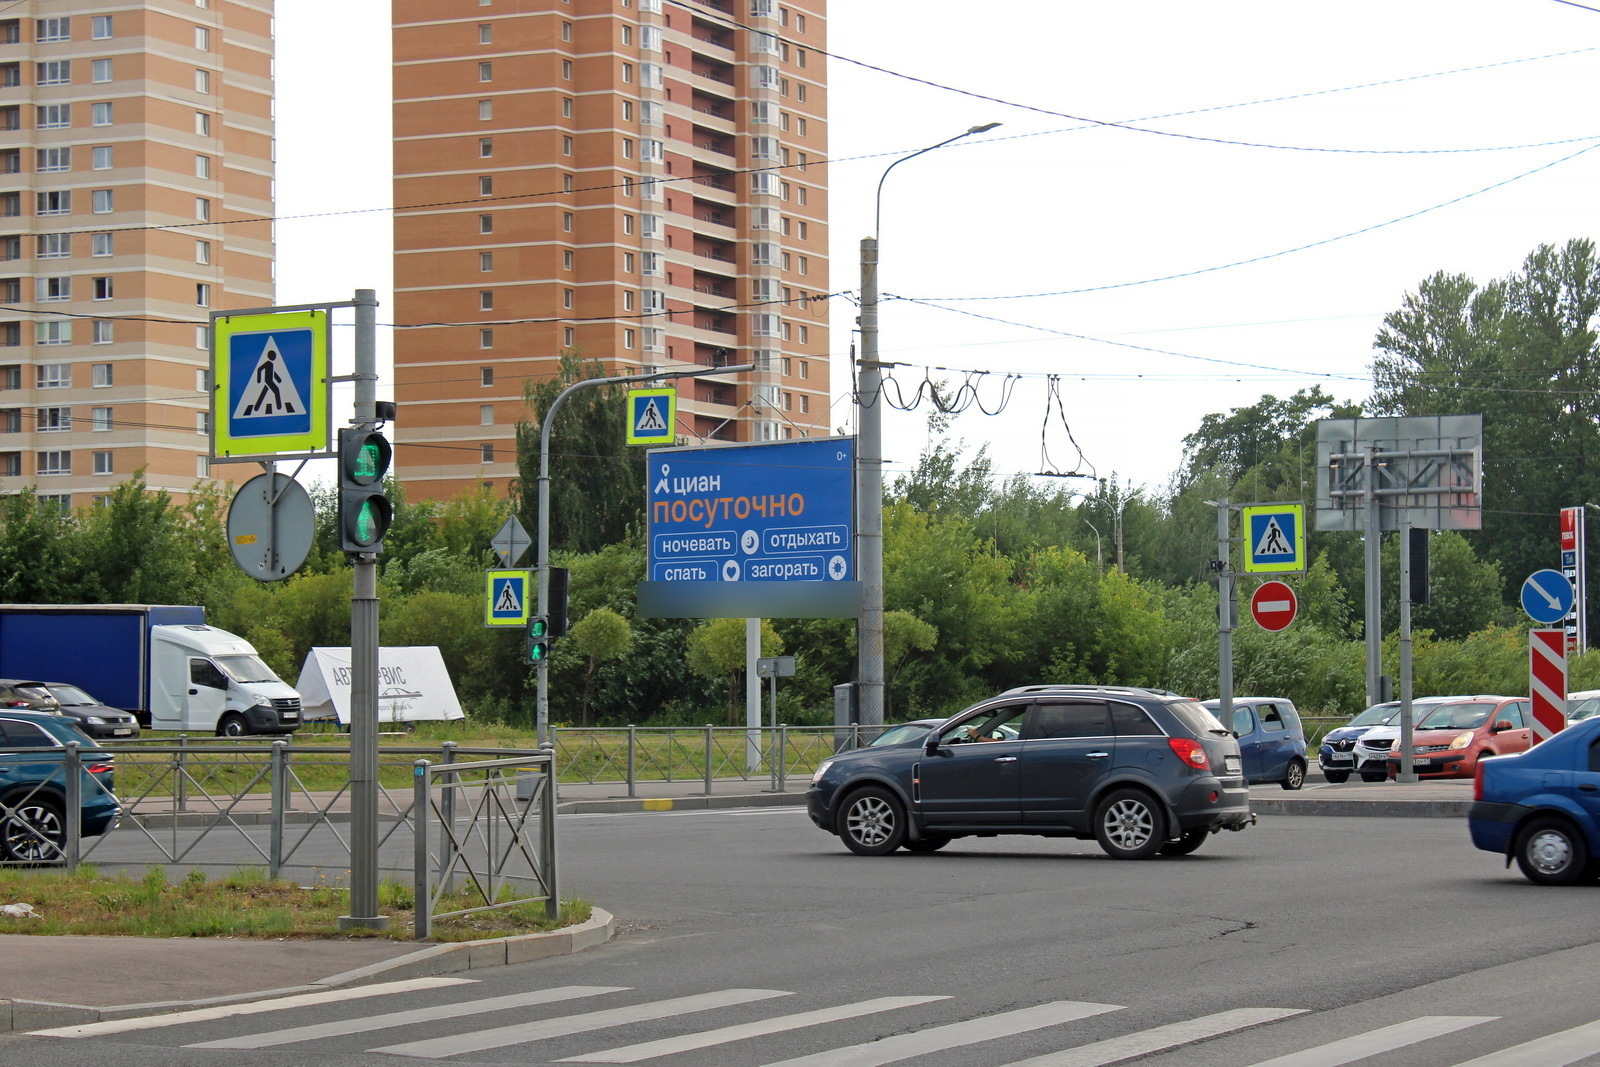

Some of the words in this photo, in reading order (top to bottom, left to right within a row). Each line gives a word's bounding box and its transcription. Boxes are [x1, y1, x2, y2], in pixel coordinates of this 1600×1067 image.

[836, 451, 847, 461] 0+
[673, 474, 721, 496] циан
[653, 492, 805, 529] посуточно
[662, 537, 731, 553] ночевать
[770, 531, 841, 550] отдыхать
[664, 566, 707, 581] спать
[751, 562, 819, 580] загорать
